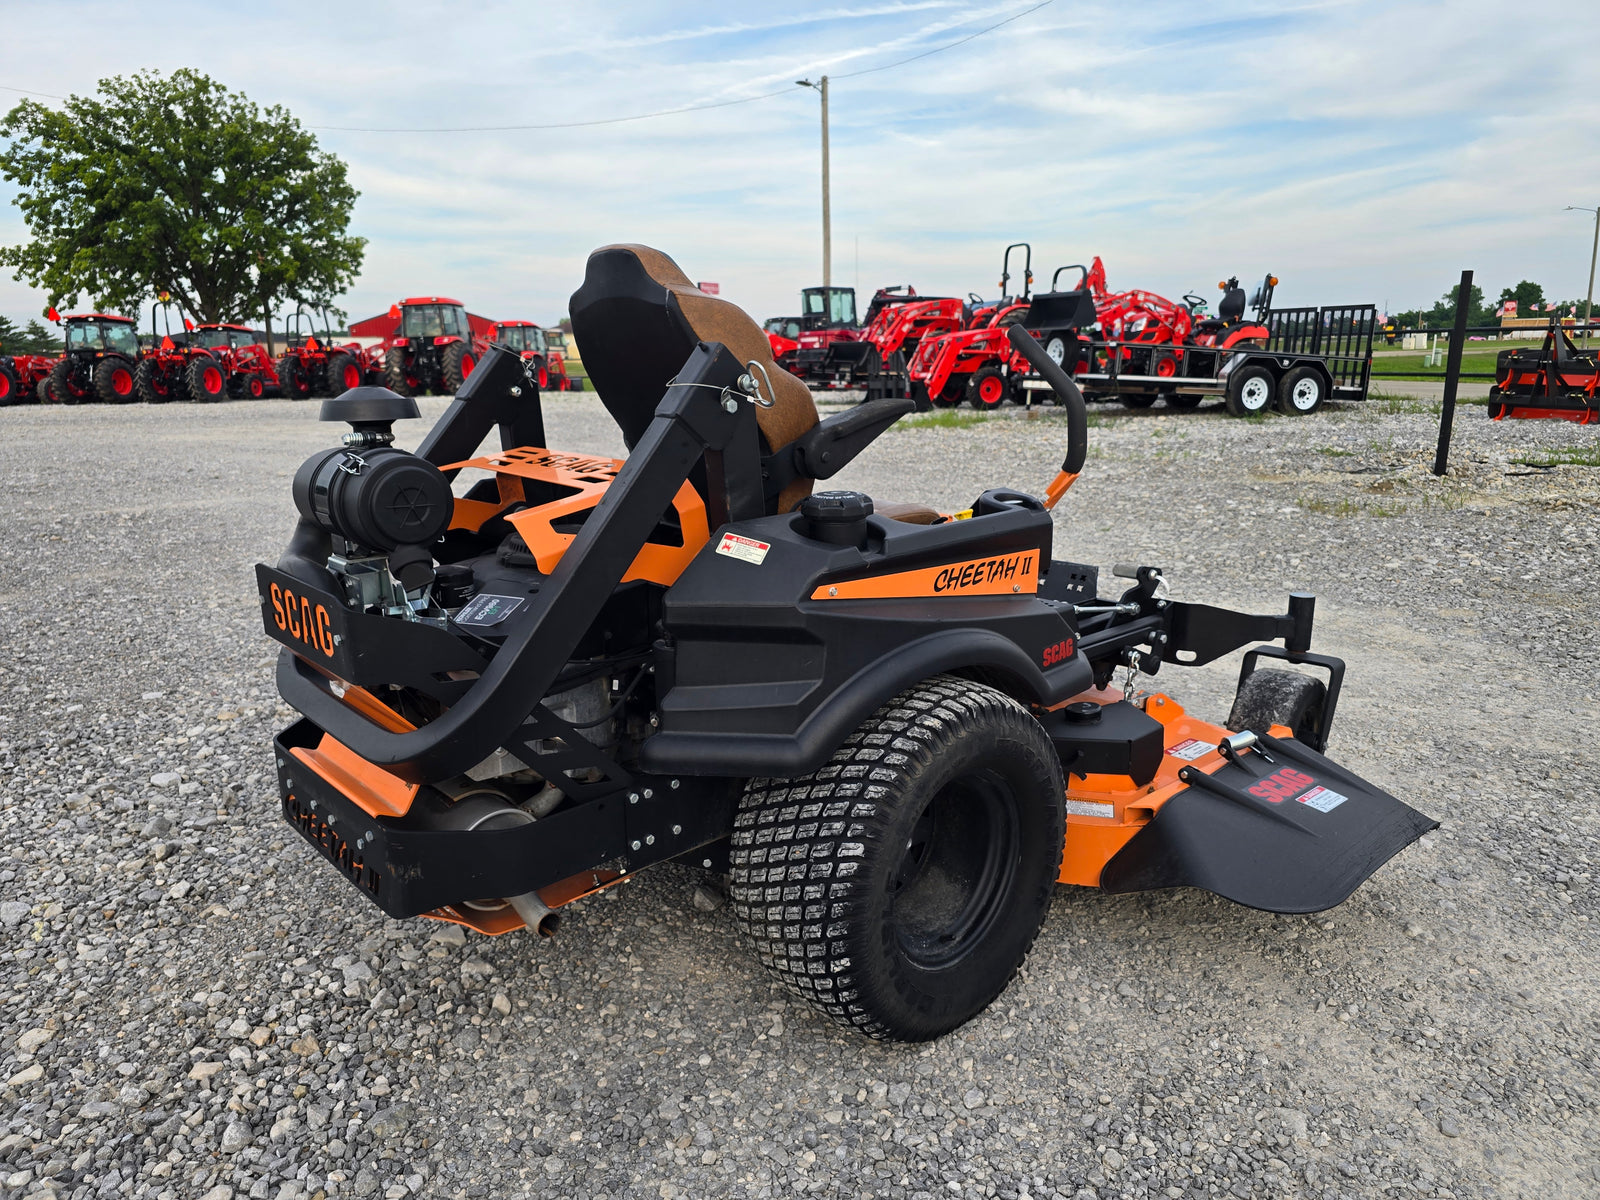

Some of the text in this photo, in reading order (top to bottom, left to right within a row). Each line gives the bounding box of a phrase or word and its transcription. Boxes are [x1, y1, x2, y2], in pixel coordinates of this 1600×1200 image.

[933, 556, 1033, 593] CHEETAH II
[270, 582, 334, 657] SCAG
[1042, 638, 1074, 667] SCAG
[1248, 768, 1314, 803] SCAG
[285, 794, 364, 885] CHEETAH
